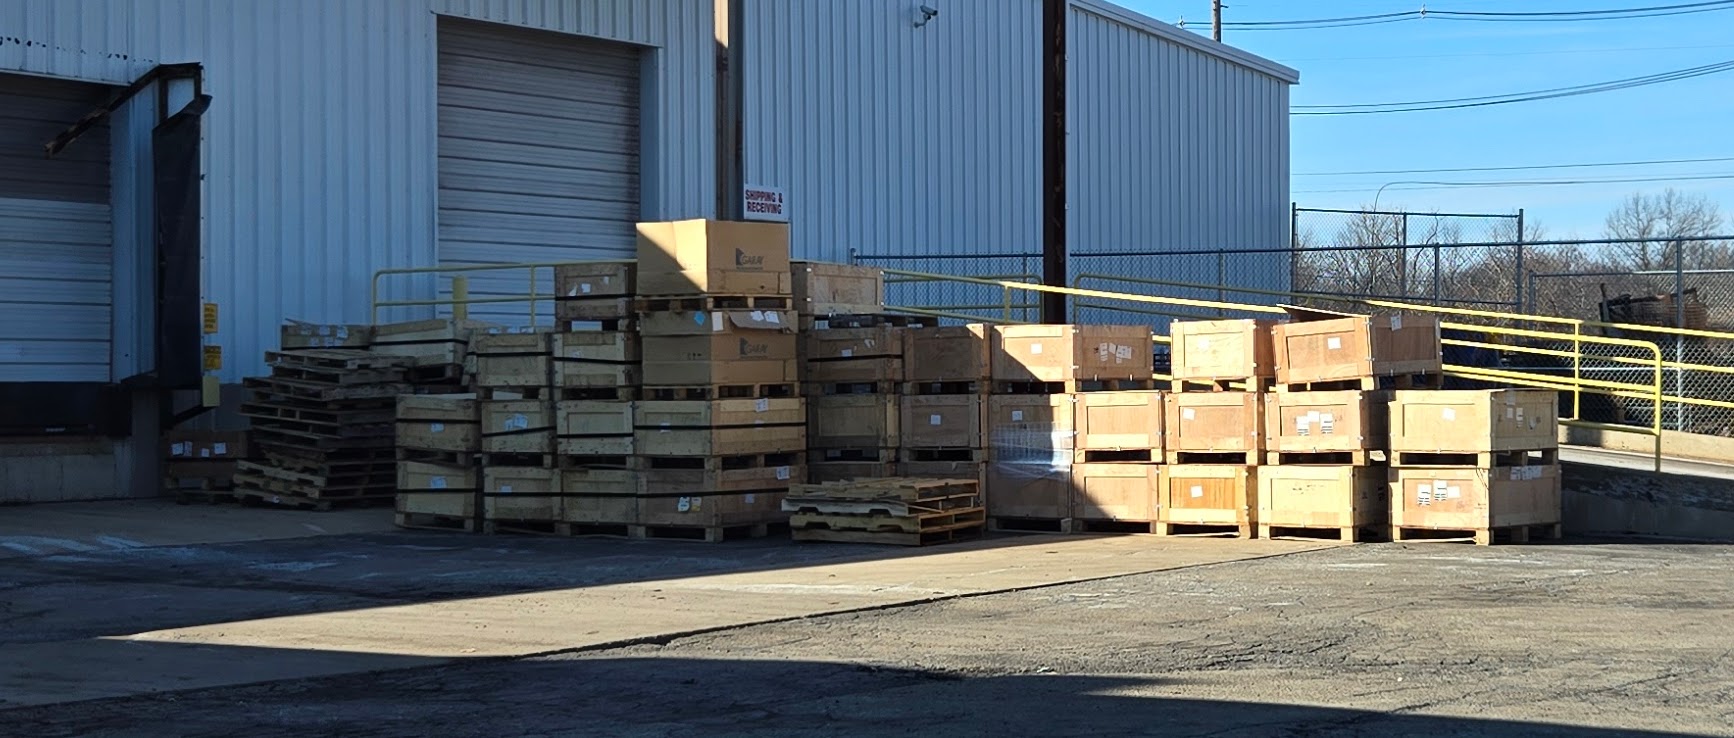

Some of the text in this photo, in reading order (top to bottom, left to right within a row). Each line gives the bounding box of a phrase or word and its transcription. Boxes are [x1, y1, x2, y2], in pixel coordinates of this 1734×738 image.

[745, 189, 783, 203] SHIPPING &
[747, 201, 782, 215] RECEIVING
